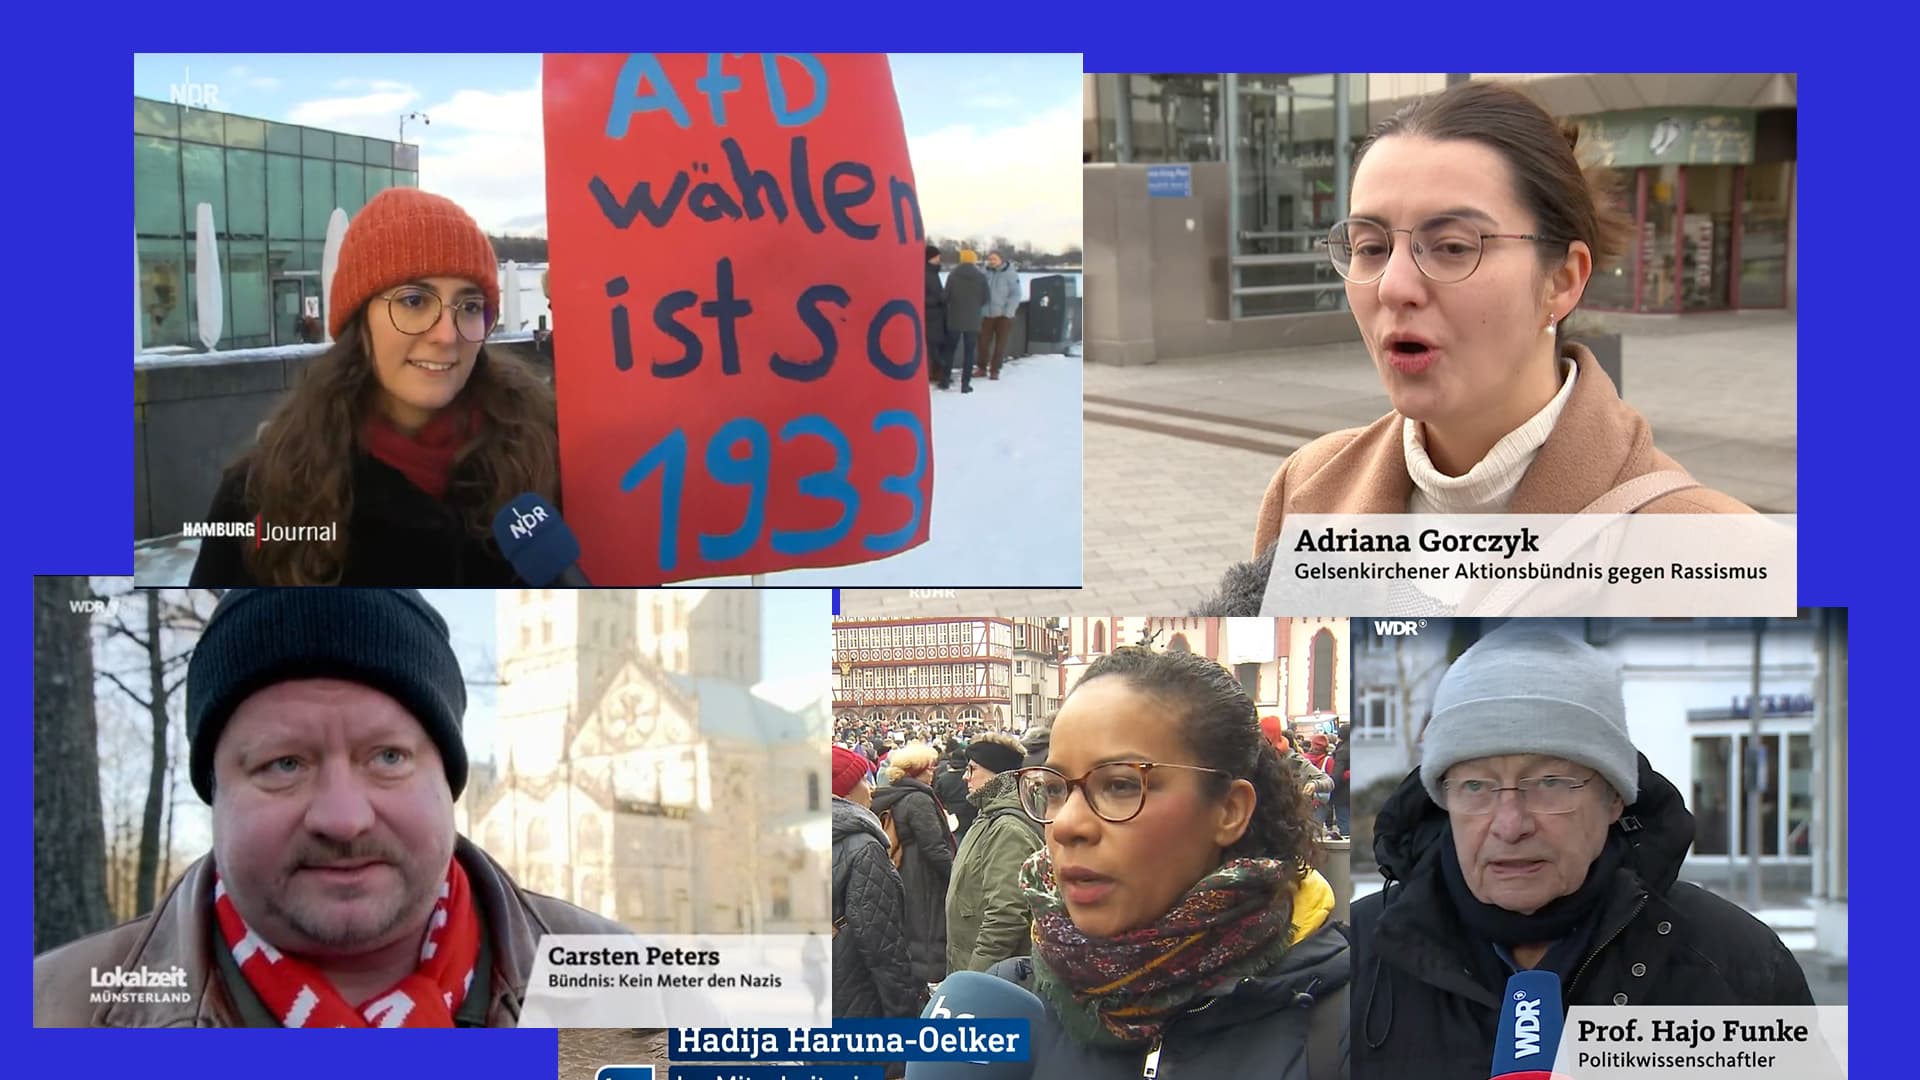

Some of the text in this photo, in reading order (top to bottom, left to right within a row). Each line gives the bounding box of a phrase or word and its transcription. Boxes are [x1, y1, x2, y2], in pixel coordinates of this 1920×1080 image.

[605, 53, 830, 138] AfD
[589, 136, 924, 245] wählen
[605, 257, 923, 382] ist so
[509, 505, 549, 539] NDR
[621, 409, 926, 571] 1933
[1515, 998, 1541, 1060] WDR
